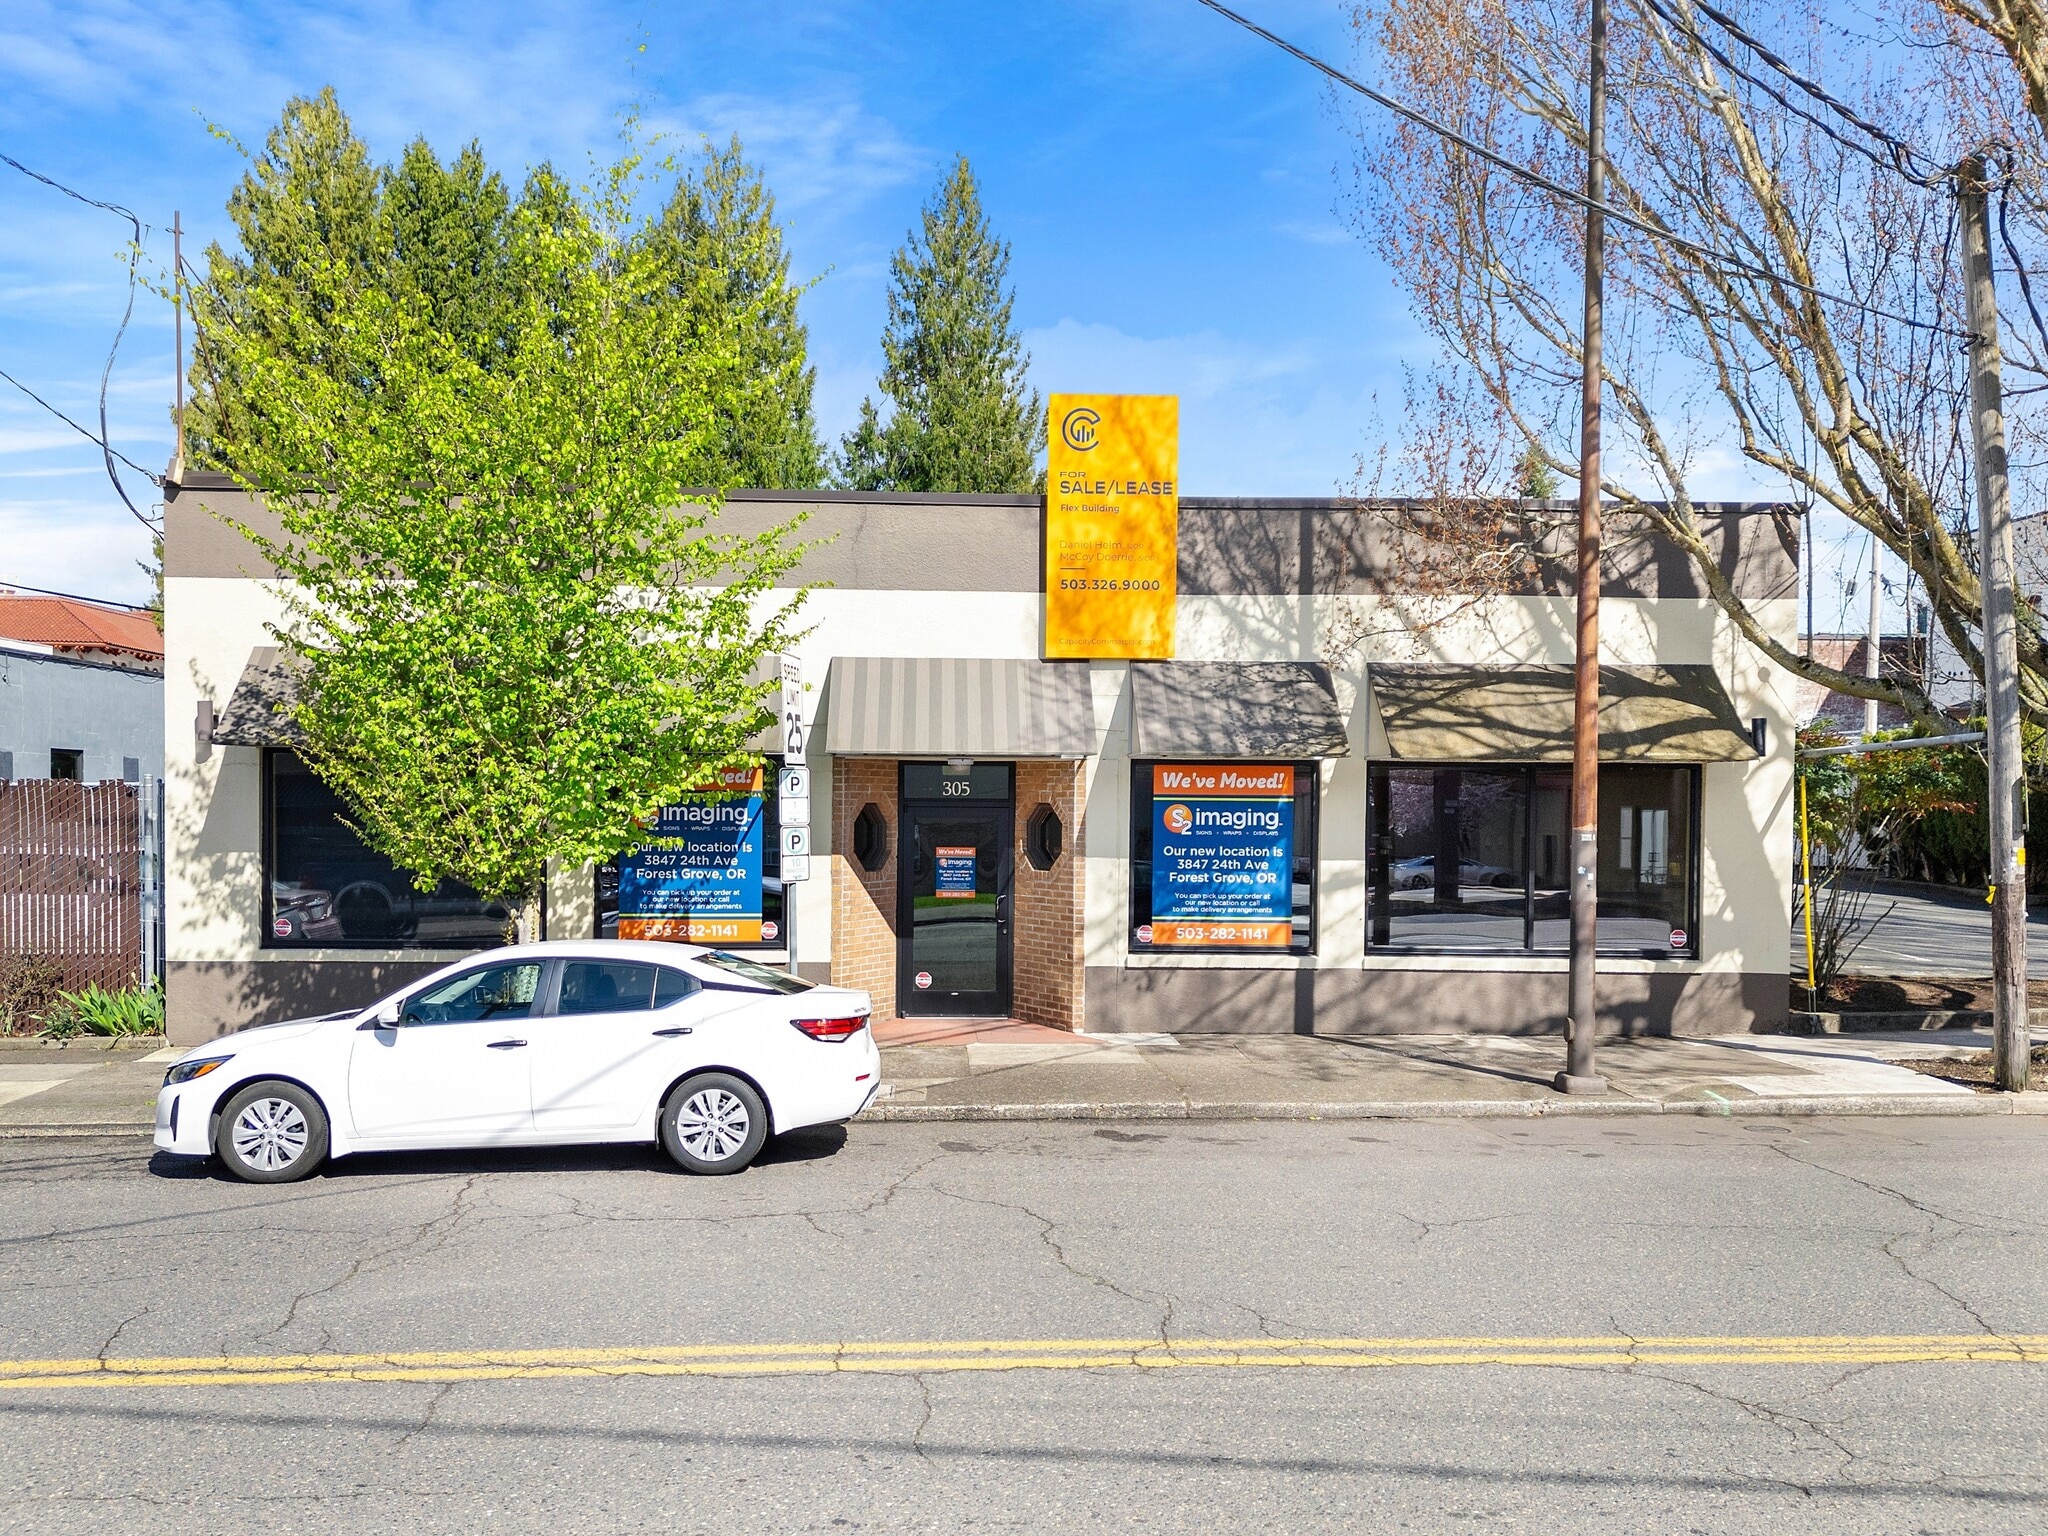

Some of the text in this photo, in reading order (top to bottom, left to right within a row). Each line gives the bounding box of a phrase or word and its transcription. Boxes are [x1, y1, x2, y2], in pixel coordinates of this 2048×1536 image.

[1060, 480, 1173, 496] SALE/LEASE
[1060, 504, 1120, 514] Flex Building
[1060, 540, 1092, 549] Daniel
[1060, 552, 1094, 562] McCoy
[1060, 580, 1160, 590] 503.326.9000
[784, 663, 800, 684] SPEED
[786, 712, 802, 754] 25
[790, 776, 800, 792] P
[1162, 772, 1285, 789] We've Moved!
[942, 781, 970, 796] 305
[663, 804, 748, 825] imaging
[1196, 808, 1279, 830] imaging
[688, 842, 739, 852] location
[742, 842, 753, 853] is
[792, 834, 801, 850] P
[1164, 846, 1284, 857] Our new location is
[644, 855, 739, 866] 3847 24th Ave
[1177, 859, 1269, 870] 3847 24th Ave
[636, 868, 747, 880] Forest Grove, OR
[1169, 872, 1277, 884] Forest Grove, OR
[644, 925, 738, 937] 503-282-1141
[1176, 928, 1268, 939] 503-282-1141
